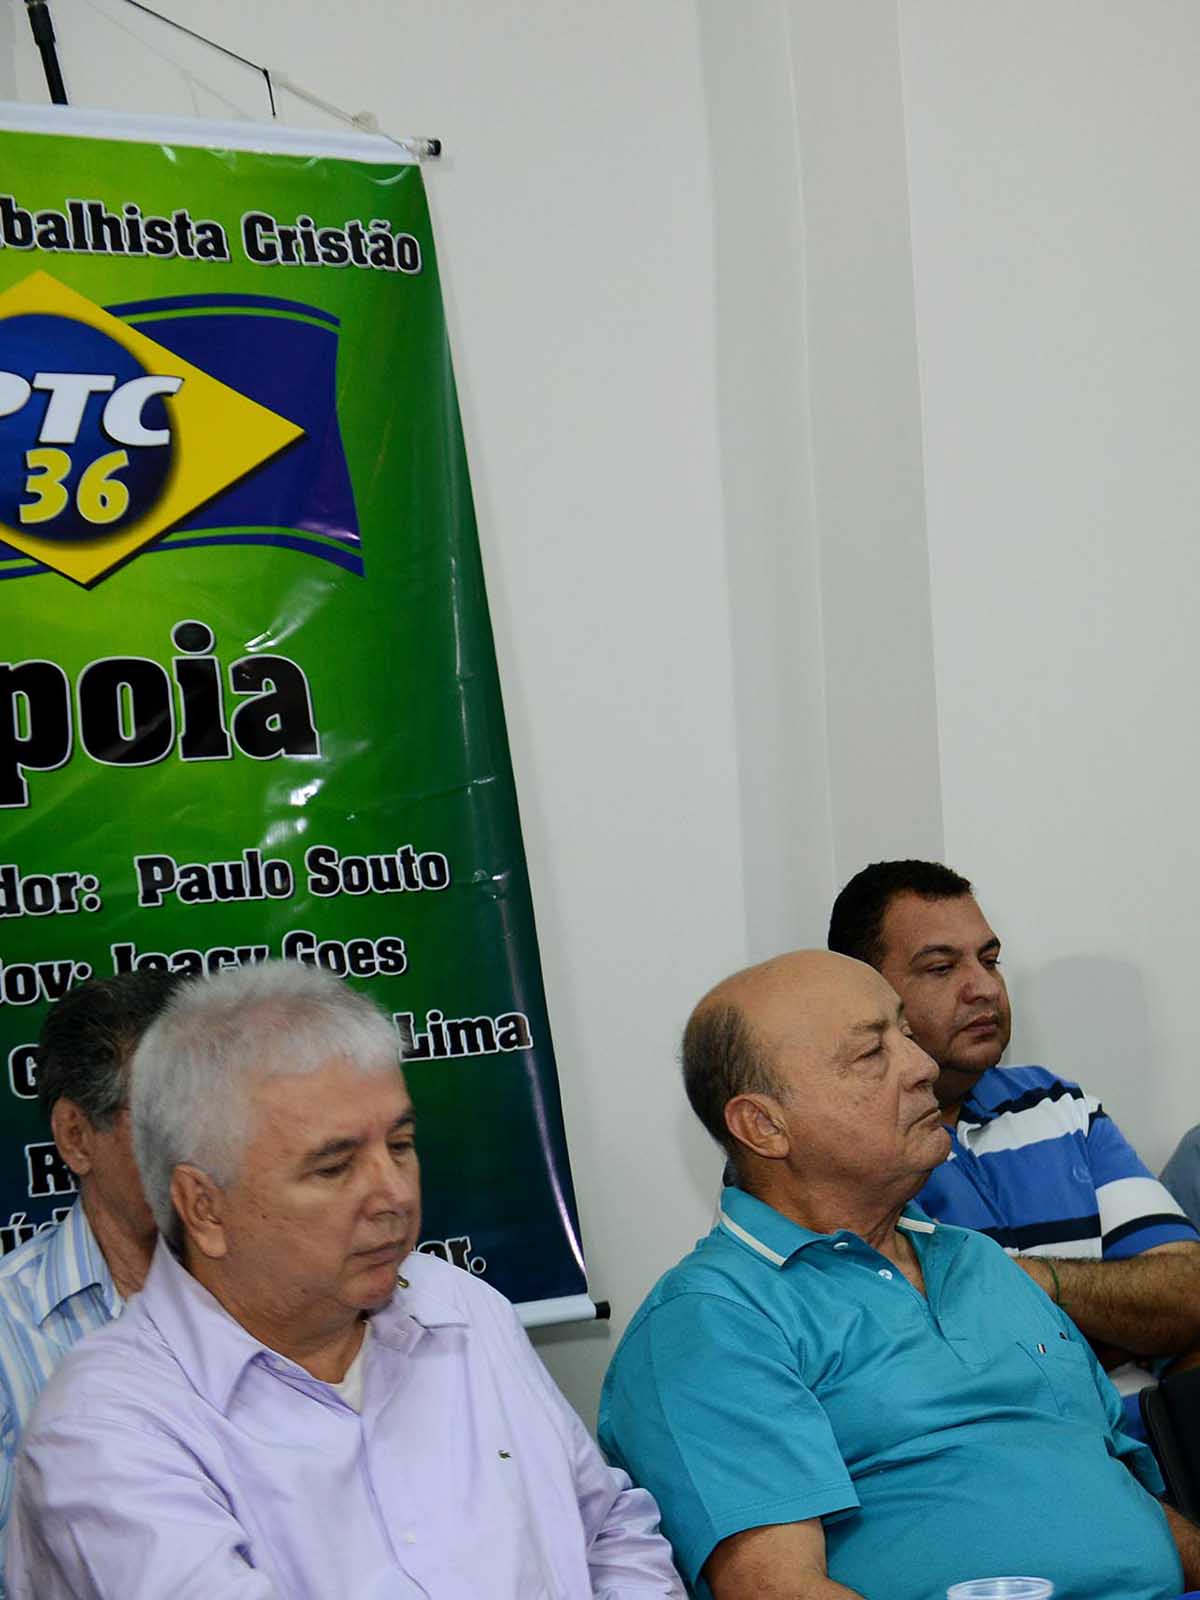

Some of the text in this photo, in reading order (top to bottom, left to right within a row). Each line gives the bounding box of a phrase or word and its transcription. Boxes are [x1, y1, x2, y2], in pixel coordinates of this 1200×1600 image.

[0, 194, 422, 275] balhista Cristão
[19, 447, 129, 524] 36
[134, 848, 294, 907] Paulo
[304, 844, 449, 897] Souto
[282, 929, 407, 979] Goes
[393, 1009, 534, 1062] Lima
